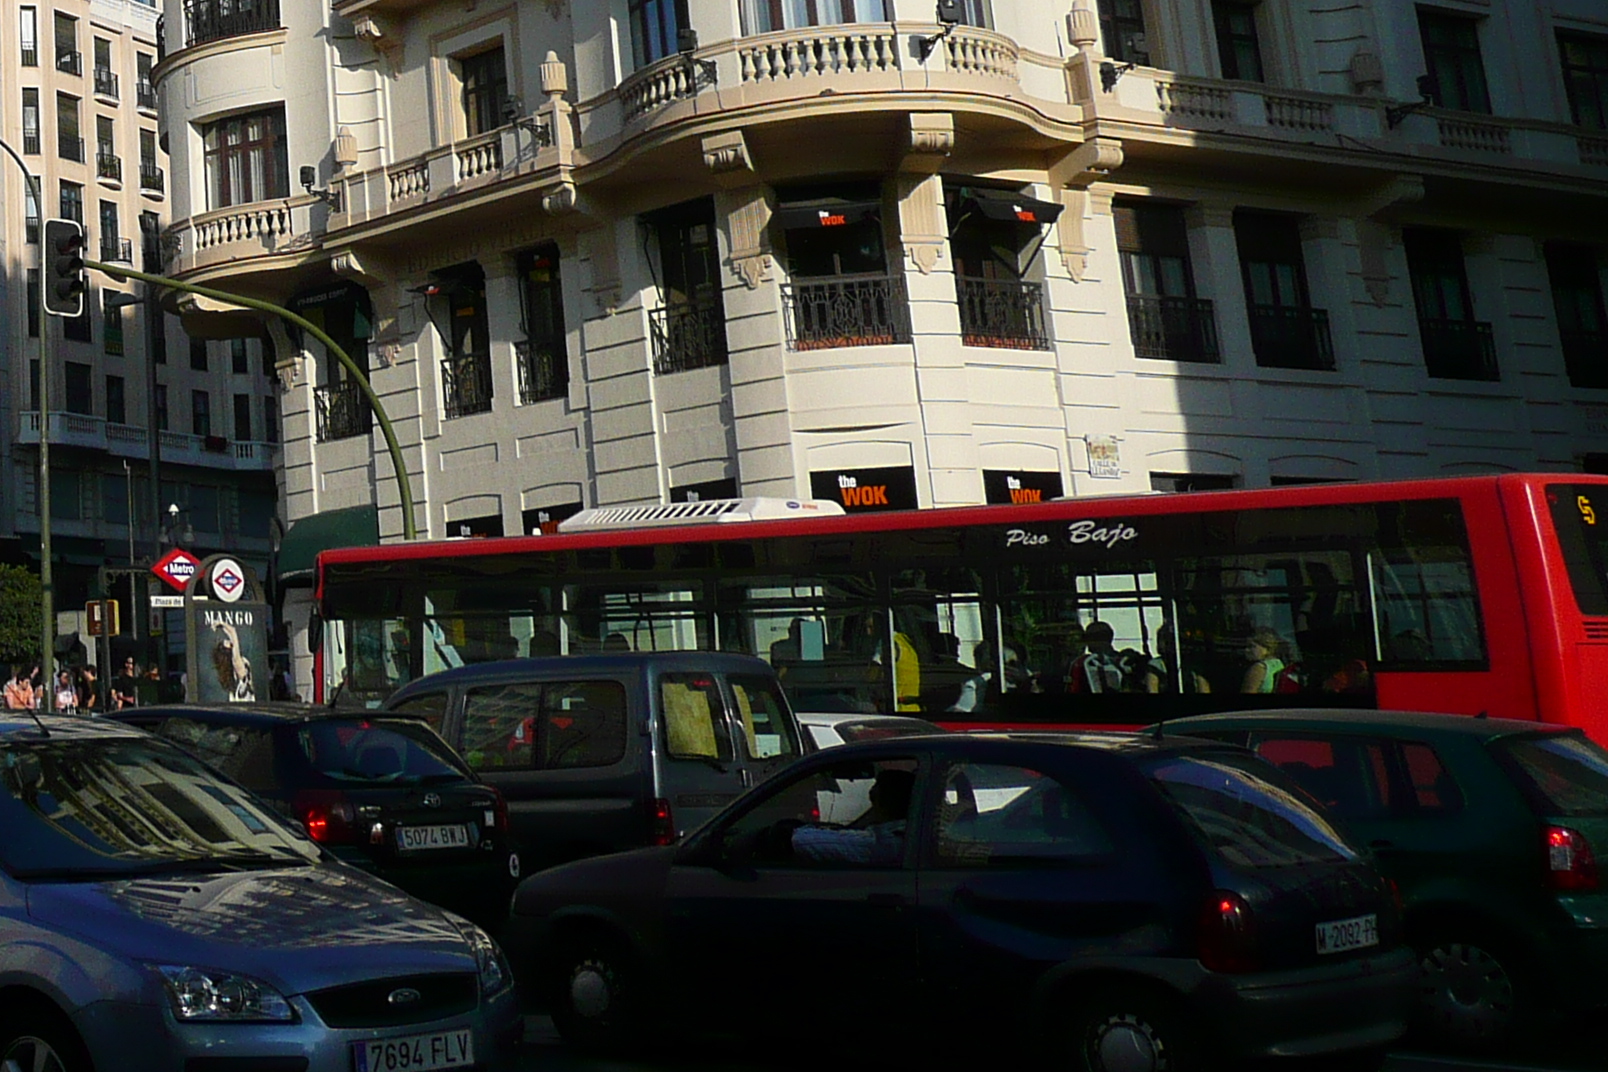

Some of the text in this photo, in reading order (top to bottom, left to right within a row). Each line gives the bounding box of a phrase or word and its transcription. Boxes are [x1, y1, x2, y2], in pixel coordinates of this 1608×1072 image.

[821, 215, 846, 226] WOK
[838, 475, 856, 488] the
[842, 485, 888, 506] WOK
[1010, 489, 1041, 504] WOK
[1006, 520, 1139, 549] Piso Bajo
[169, 562, 195, 574] Metro
[204, 610, 253, 626] MANGO
[405, 829, 438, 847] 5074
[371, 1033, 468, 1072] 7694 FLV
